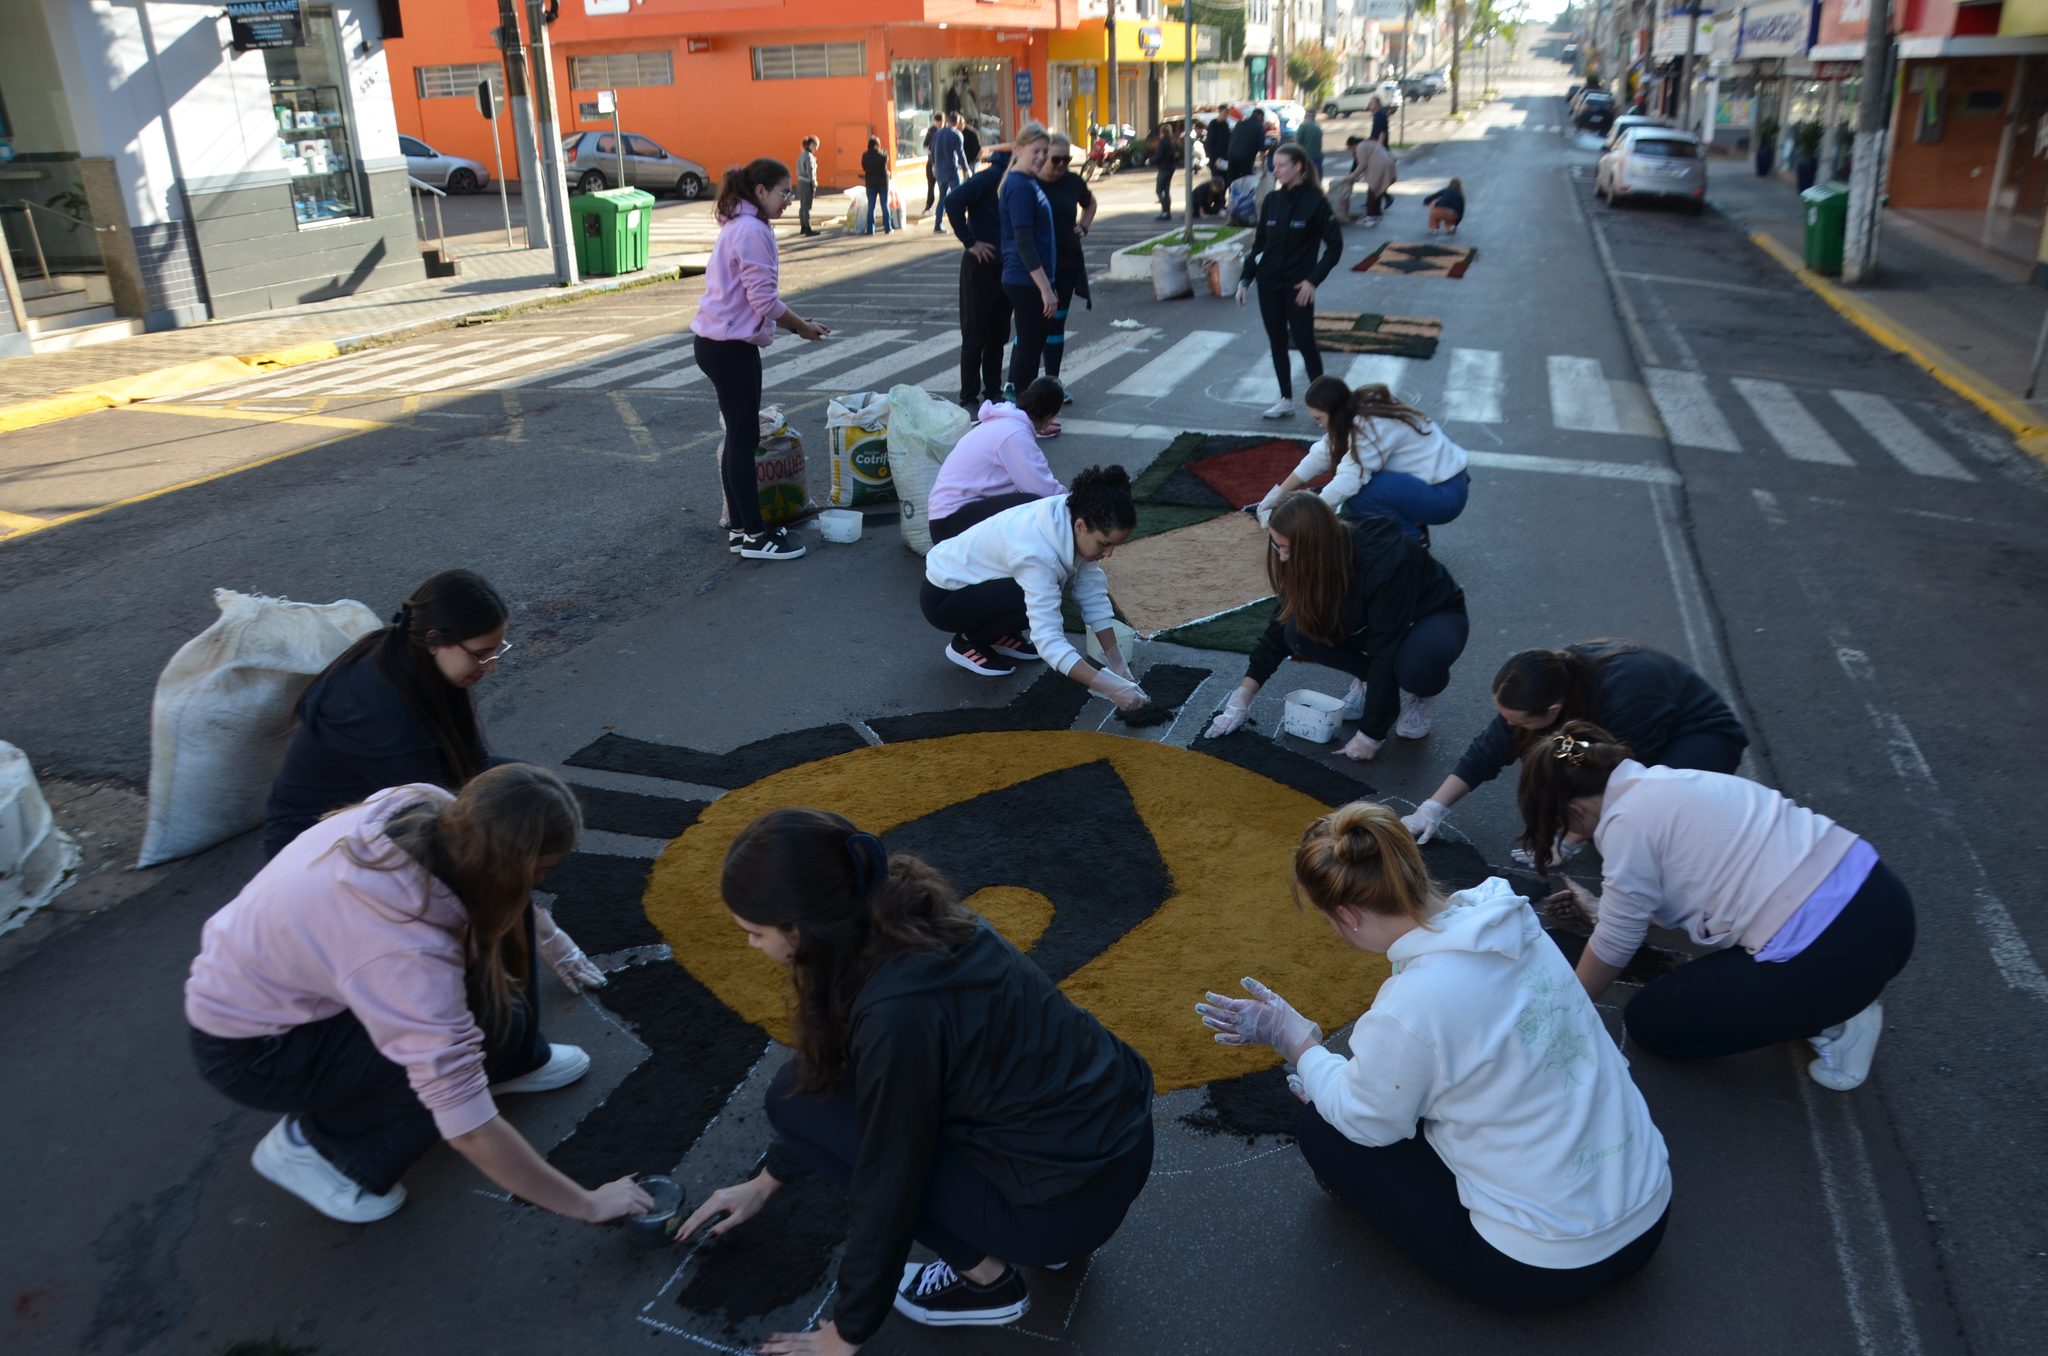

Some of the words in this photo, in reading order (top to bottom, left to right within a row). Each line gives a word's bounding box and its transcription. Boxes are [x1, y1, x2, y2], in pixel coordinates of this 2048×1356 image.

[228, 3, 265, 17] MANIA
[265, 0, 298, 14] GAME
[856, 452, 888, 465] Cotrif
